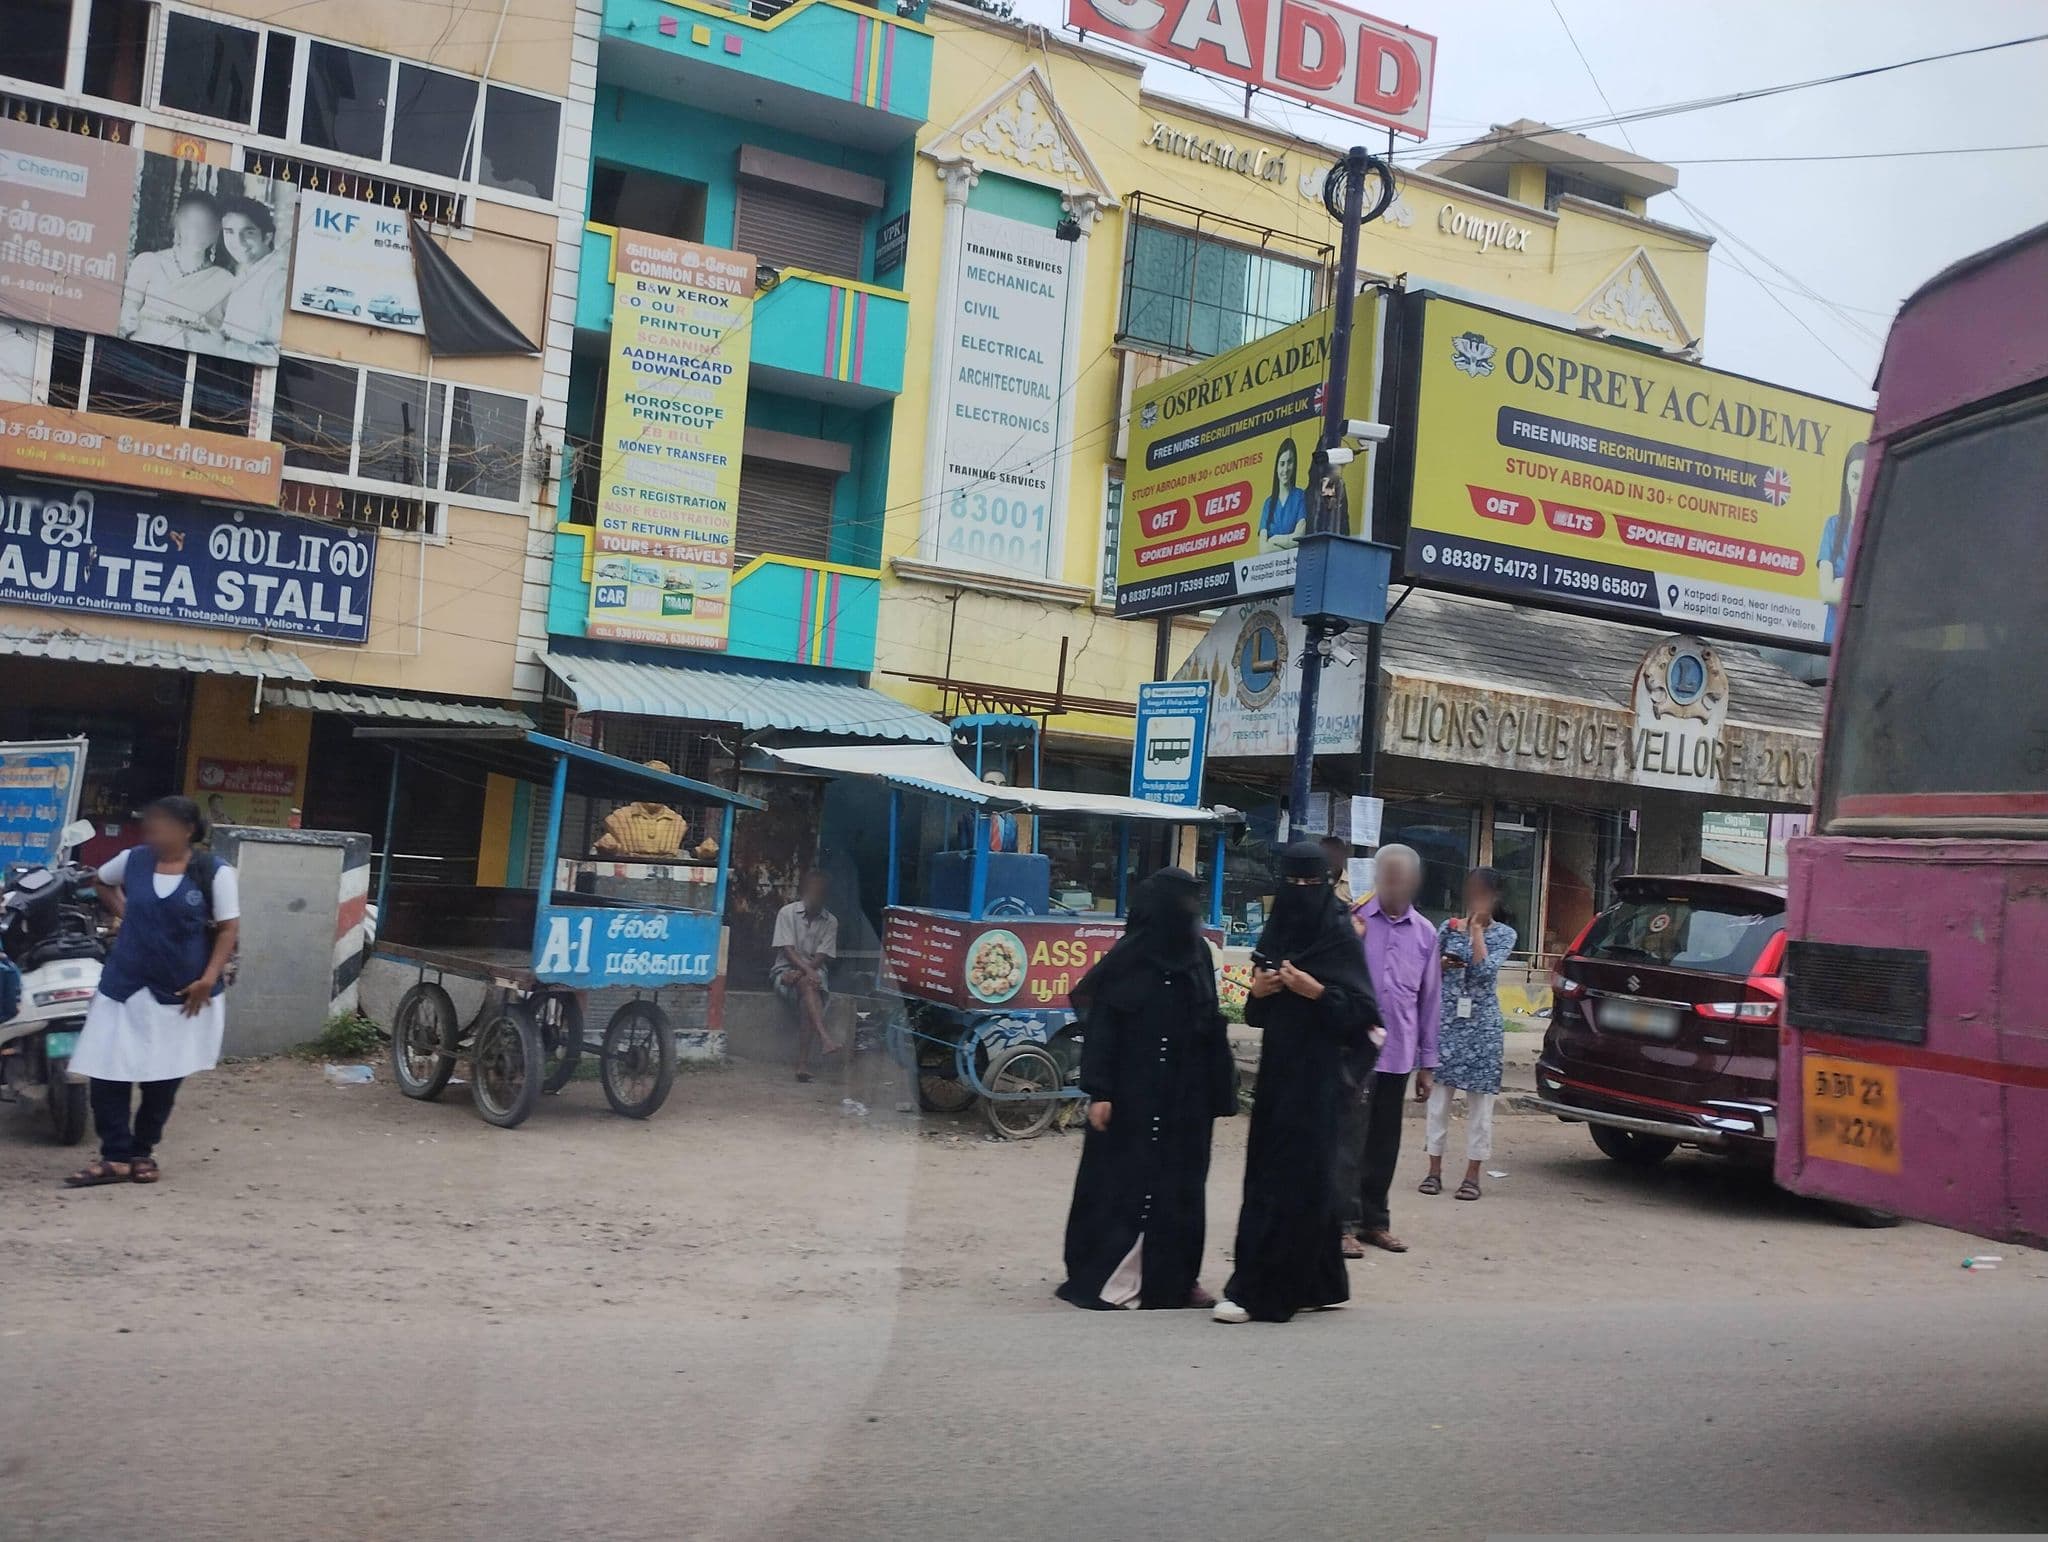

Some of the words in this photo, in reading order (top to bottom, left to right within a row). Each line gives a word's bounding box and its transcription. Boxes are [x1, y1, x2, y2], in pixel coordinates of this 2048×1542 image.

[17, 159, 85, 183] Chennai
[315, 207, 360, 234] IKF
[376, 220, 403, 236] IKF
[1438, 203, 1531, 254] Complex
[966, 242, 1013, 263] TRAINING
[1017, 254, 1063, 275] SERVICES
[631, 259, 692, 285] COMMON
[696, 272, 742, 294] E-SEVA
[967, 265, 1055, 298] MECHANICAL
[636, 280, 671, 296] B&W
[677, 288, 729, 308] XEROX
[964, 300, 1000, 320] CIVIL
[640, 315, 722, 339] PRINTOUT
[637, 330, 722, 357] SCANNING
[961, 335, 1044, 364] ELECTRICAL
[622, 346, 733, 375] AADHARCARD
[631, 360, 722, 386] DOWNLOAD
[959, 366, 1051, 400] ARCHITECTURAL
[1162, 371, 1239, 420] OSPREY
[1240, 334, 1337, 392] ACADEM
[624, 392, 724, 419] HOROSCOPE
[1505, 346, 1655, 414] OSPREY
[1660, 385, 1832, 456] ACADEMY
[632, 407, 714, 430] PRINTOUT
[956, 403, 1049, 434] ELECTRONICS
[1153, 444, 1173, 460] FREE
[1173, 434, 1200, 453] NURSE
[1200, 415, 1262, 445] RECRUITMENT
[1261, 411, 1274, 425] TO
[1274, 404, 1295, 420] THE
[1294, 397, 1309, 413] UK
[618, 439, 662, 455] MONEY
[666, 447, 727, 466] TRANSFER
[1512, 420, 1549, 443] FREE
[1550, 429, 1598, 453] NURSE
[1599, 439, 1693, 474] RECRUITMENT
[1694, 461, 1712, 478] TO
[1713, 466, 1740, 484] THE
[1739, 471, 1757, 488] UK
[949, 463, 997, 480] TRAINING
[999, 472, 1046, 490] SERVICES
[1132, 484, 1156, 500] STUDY
[1155, 476, 1188, 494] ABROAD
[1187, 473, 1197, 486] IN
[1214, 452, 1263, 478] COUNTRIES
[1505, 457, 1559, 483] STUDY
[1560, 469, 1625, 496] ABROAD
[1628, 482, 1643, 500] IN
[1646, 486, 1674, 505] 30+
[1677, 494, 1758, 524] COUNTRIES
[611, 485, 636, 499] GST
[640, 489, 727, 511] REGISTRATION
[950, 489, 1044, 532] 83001
[1205, 491, 1241, 516] IELTS
[1486, 497, 1519, 517] OET
[603, 518, 628, 531] GST
[631, 522, 680, 538] RETURN
[684, 529, 729, 544] FILLING
[644, 507, 730, 528] REGISTRATION
[1152, 509, 1177, 529] OET
[133, 512, 169, 553] டீ
[208, 511, 369, 578] ஸ்டால்
[601, 535, 649, 555] TOURS
[669, 546, 727, 565] TRAVELS
[947, 525, 1042, 566] 40001
[1140, 545, 1174, 564] SPOKEN
[1173, 537, 1209, 556] ENGLISH
[1210, 535, 1218, 547] &
[1218, 528, 1246, 545] MORE
[1626, 525, 1686, 550] SPOKEN
[1687, 536, 1745, 561] ENGLISH
[1747, 549, 1757, 562] &
[1760, 551, 1799, 571] MORE
[1204, 571, 1230, 588] 65807
[1441, 547, 1491, 571] 88387
[1494, 556, 1538, 580] 54173
[1554, 568, 1600, 591] 75399
[1602, 576, 1648, 599] 65807
[98, 555, 198, 606] TEA
[214, 570, 364, 626] STALL
[597, 587, 626, 605] CAR
[1684, 588, 1720, 602] Katpadi
[1748, 598, 1768, 610] Near
[1770, 602, 1800, 616] Indhira
[76, 595, 132, 611] Chatiram
[265, 617, 304, 632] Vellore
[1683, 601, 1721, 616] Hospital
[1722, 606, 1754, 620] Gandhi
[1401, 693, 1489, 749] LIONS
[1496, 709, 1571, 761] CLUB
[1581, 722, 1618, 766] OF
[1623, 725, 1747, 783] VELLORE
[1145, 793, 1162, 803] BUS
[1163, 793, 1186, 803] STOP
[535, 916, 593, 974] A-1
[1031, 940, 1087, 967] ASS
